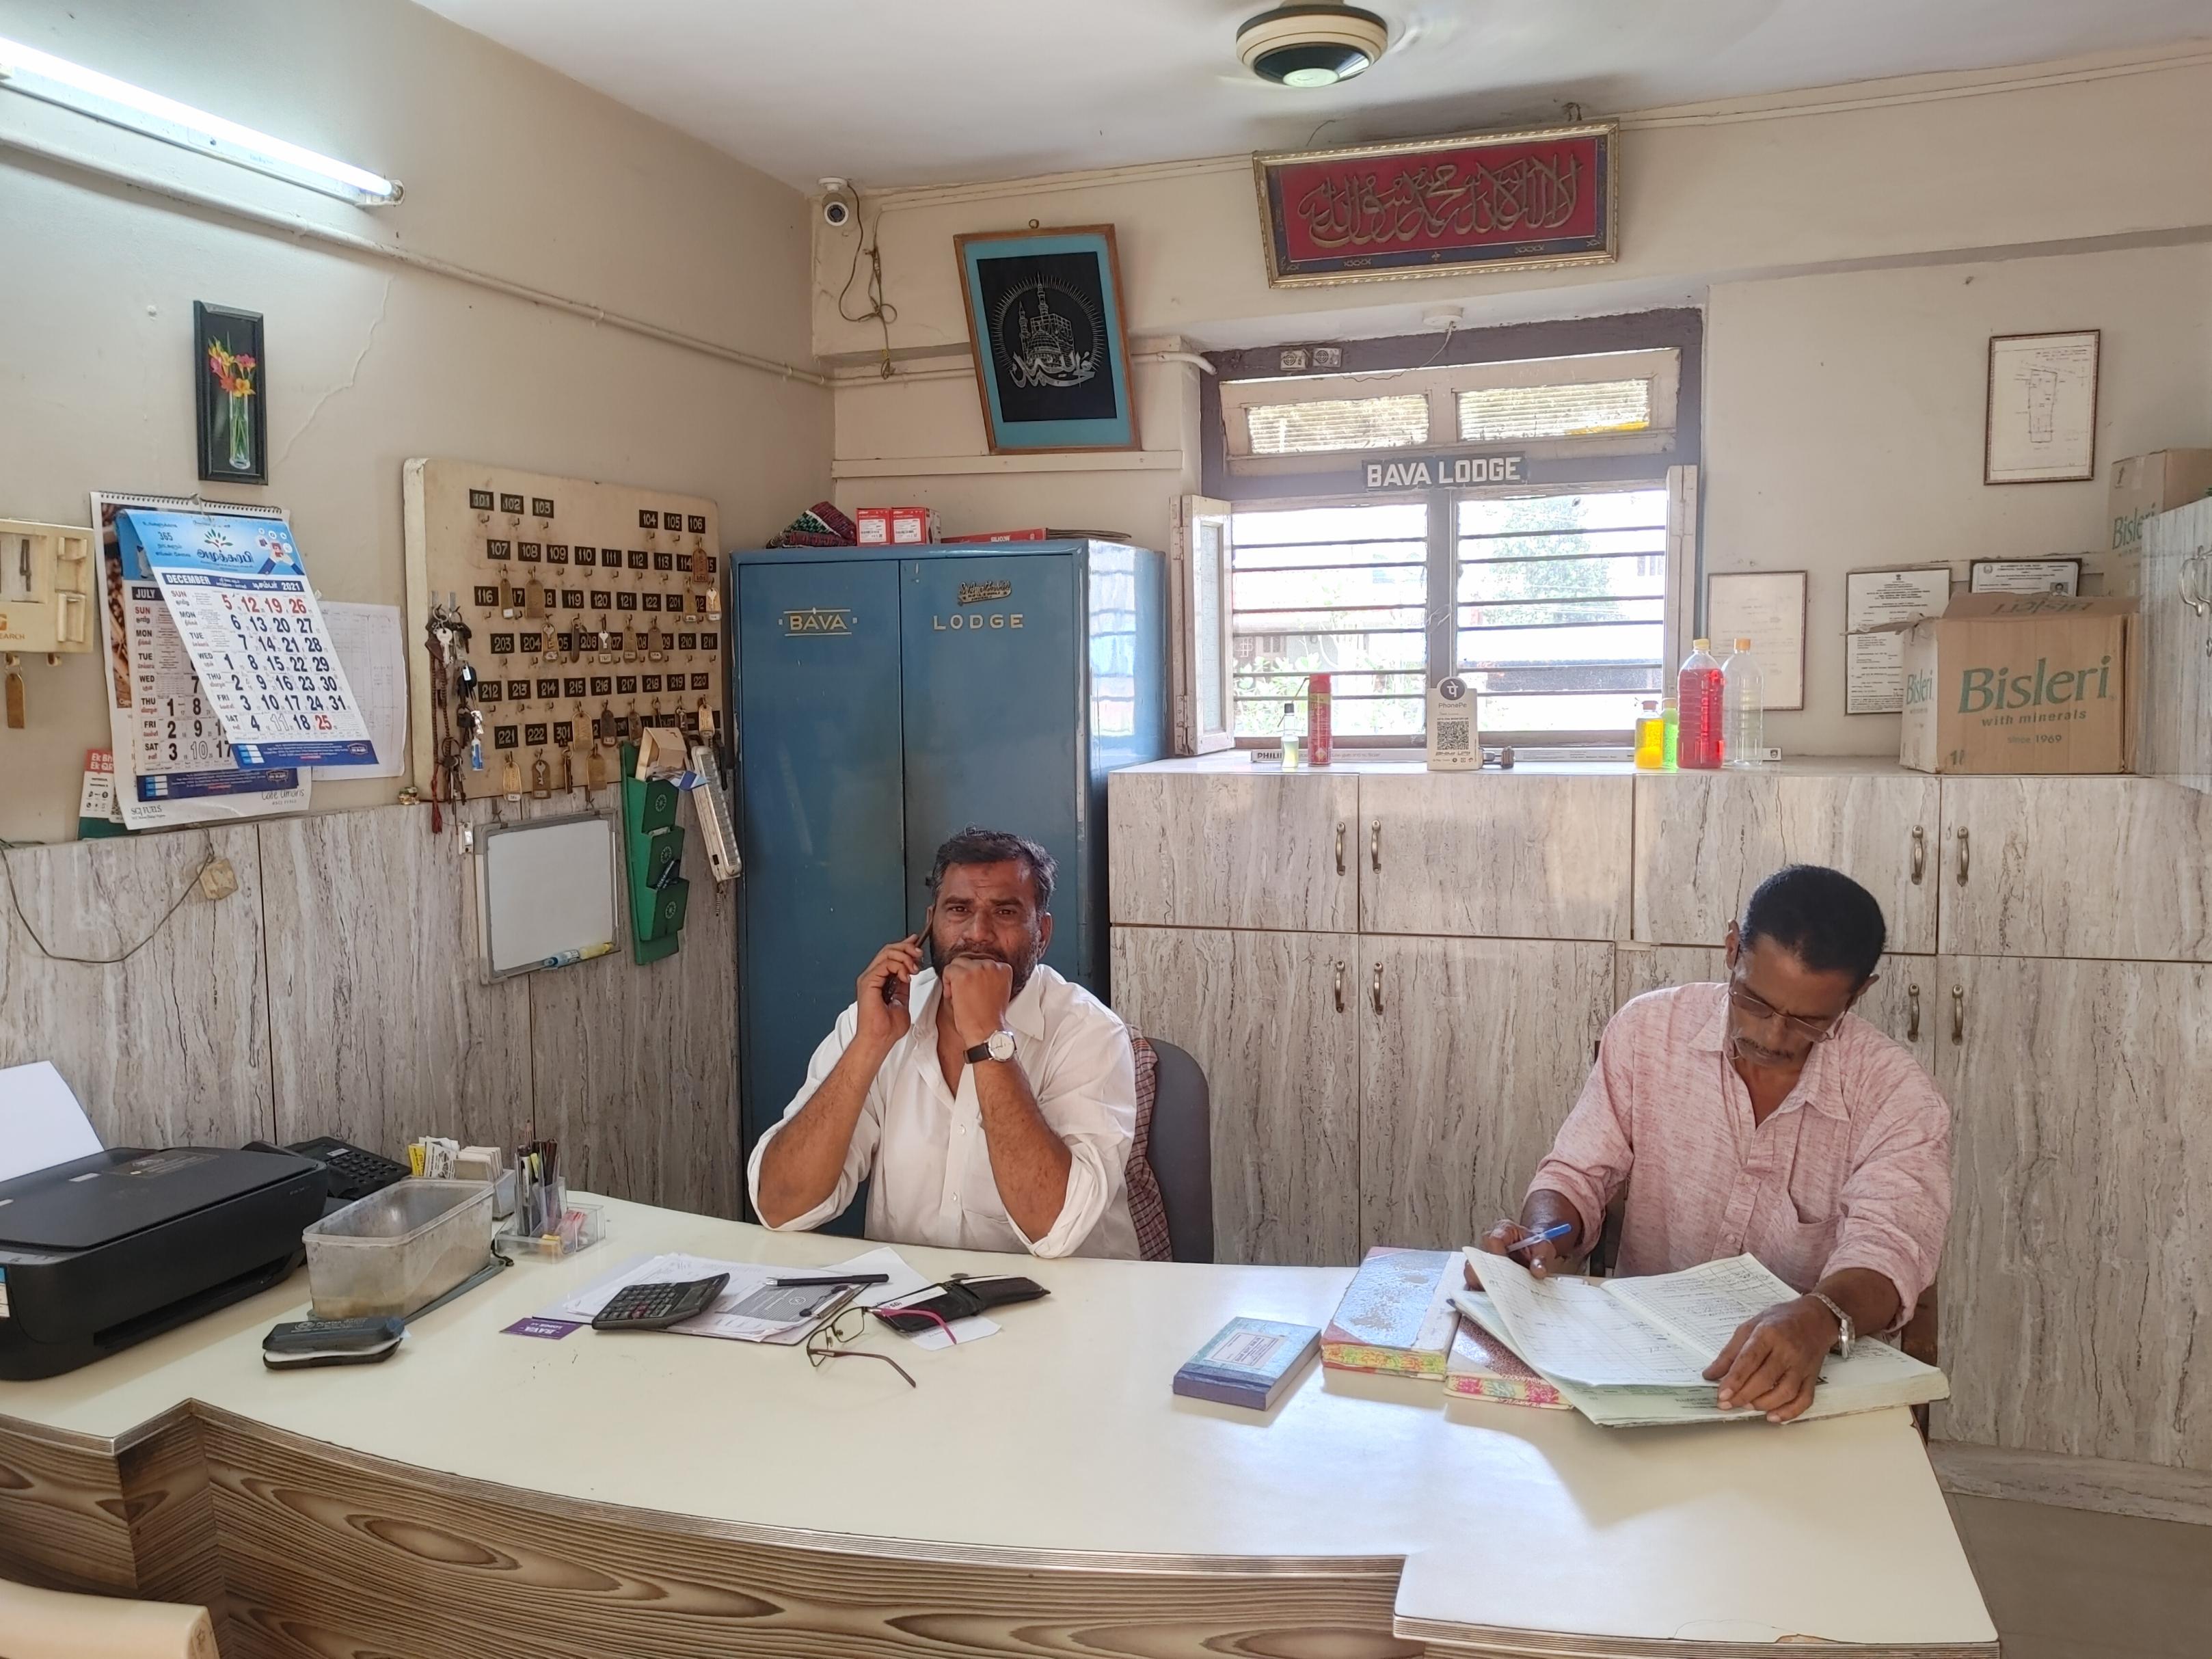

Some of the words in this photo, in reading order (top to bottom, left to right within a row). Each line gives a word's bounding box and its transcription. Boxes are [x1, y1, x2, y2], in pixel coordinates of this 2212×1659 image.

[1367, 462, 1432, 487] BAVA
[1438, 457, 1522, 484] LODGE
[503, 498, 520, 511] 102
[535, 501, 551, 513] 103
[643, 513, 656, 526] 104
[667, 516, 680, 528] 105
[690, 518, 703, 530] 106
[159, 532, 173, 541] 365
[491, 542, 508, 555] 107
[522, 545, 538, 557] 108
[550, 548, 566, 560] 109
[578, 550, 592, 562] 110
[606, 551, 617, 564] 111
[632, 553, 643, 566] 112
[658, 556, 669, 568] 113
[680, 557, 692, 569] 114
[166, 574, 211, 586] DECEMBER
[281, 581, 301, 591] 2021
[135, 589, 155, 598] JULY
[478, 589, 494, 603] 116
[513, 590, 523, 603] 17
[567, 593, 582, 606] 119
[594, 593, 608, 606] 120
[621, 595, 633, 607] 121
[645, 596, 658, 608] 122
[669, 596, 681, 608] 201
[696, 598, 704, 609] 02
[221, 593, 232, 610] 5
[241, 595, 260, 613] 12
[265, 597, 283, 614] 19
[289, 598, 307, 614] 26
[230, 614, 241, 630] 6
[249, 616, 267, 632] 13
[273, 617, 291, 633] 20
[297, 618, 313, 634] 27
[790, 614, 848, 630] BAVA
[932, 614, 1023, 630] LODGE
[238, 634, 248, 650] 7
[258, 636, 276, 651] 14
[282, 636, 299, 652] 21
[305, 637, 323, 652] 28
[494, 637, 511, 651] 203
[524, 636, 541, 649] 204
[558, 638, 569, 649] 05
[581, 636, 597, 648] 206
[612, 636, 622, 648] 07
[638, 636, 647, 648] 08
[662, 636, 671, 648] 09
[681, 637, 692, 648] 210
[703, 636, 714, 647] 211
[224, 653, 234, 670] 1
[247, 654, 258, 670] 8
[267, 656, 284, 671] 15
[290, 656, 308, 672] 22
[312, 656, 330, 672] 29
[191, 676, 200, 693] 7
[232, 674, 243, 691] 2
[256, 674, 267, 690] 9
[275, 675, 293, 691] 16
[298, 676, 315, 691] 23
[320, 676, 338, 691] 30
[482, 684, 498, 699] 212
[513, 684, 527, 696] 213
[541, 682, 556, 696] 214
[569, 681, 583, 694] 215
[595, 679, 608, 692] 216
[621, 679, 634, 690] 217
[646, 677, 659, 690] 218
[671, 677, 683, 688] 219
[693, 675, 707, 687] 220
[1446, 681, 1459, 697] पे
[1906, 669, 1933, 705] Bisleri
[1958, 655, 2112, 714] Bisleri
[167, 698, 174, 716] 1
[193, 697, 201, 715] 8
[241, 695, 251, 711] 3
[261, 694, 280, 710] 10
[285, 694, 301, 710] 17
[307, 695, 323, 710] 24
[329, 695, 347, 710] 31
[251, 716, 260, 731] 4
[271, 714, 290, 731] 11
[293, 714, 311, 730] 18
[315, 715, 332, 730] 25
[1982, 713, 2014, 727] with
[2019, 709, 2087, 724] minerals
[167, 720, 176, 739] 2
[193, 720, 202, 737] 9
[498, 730, 515, 744] 221
[528, 728, 544, 742] 222
[556, 726, 570, 739] 301
[2035, 734, 2062, 744] 1969
[92, 753, 101, 761] Ek
[169, 743, 178, 760] 3
[191, 740, 208, 759] 10
[216, 740, 232, 758] 17
[90, 761, 100, 770] Ek
